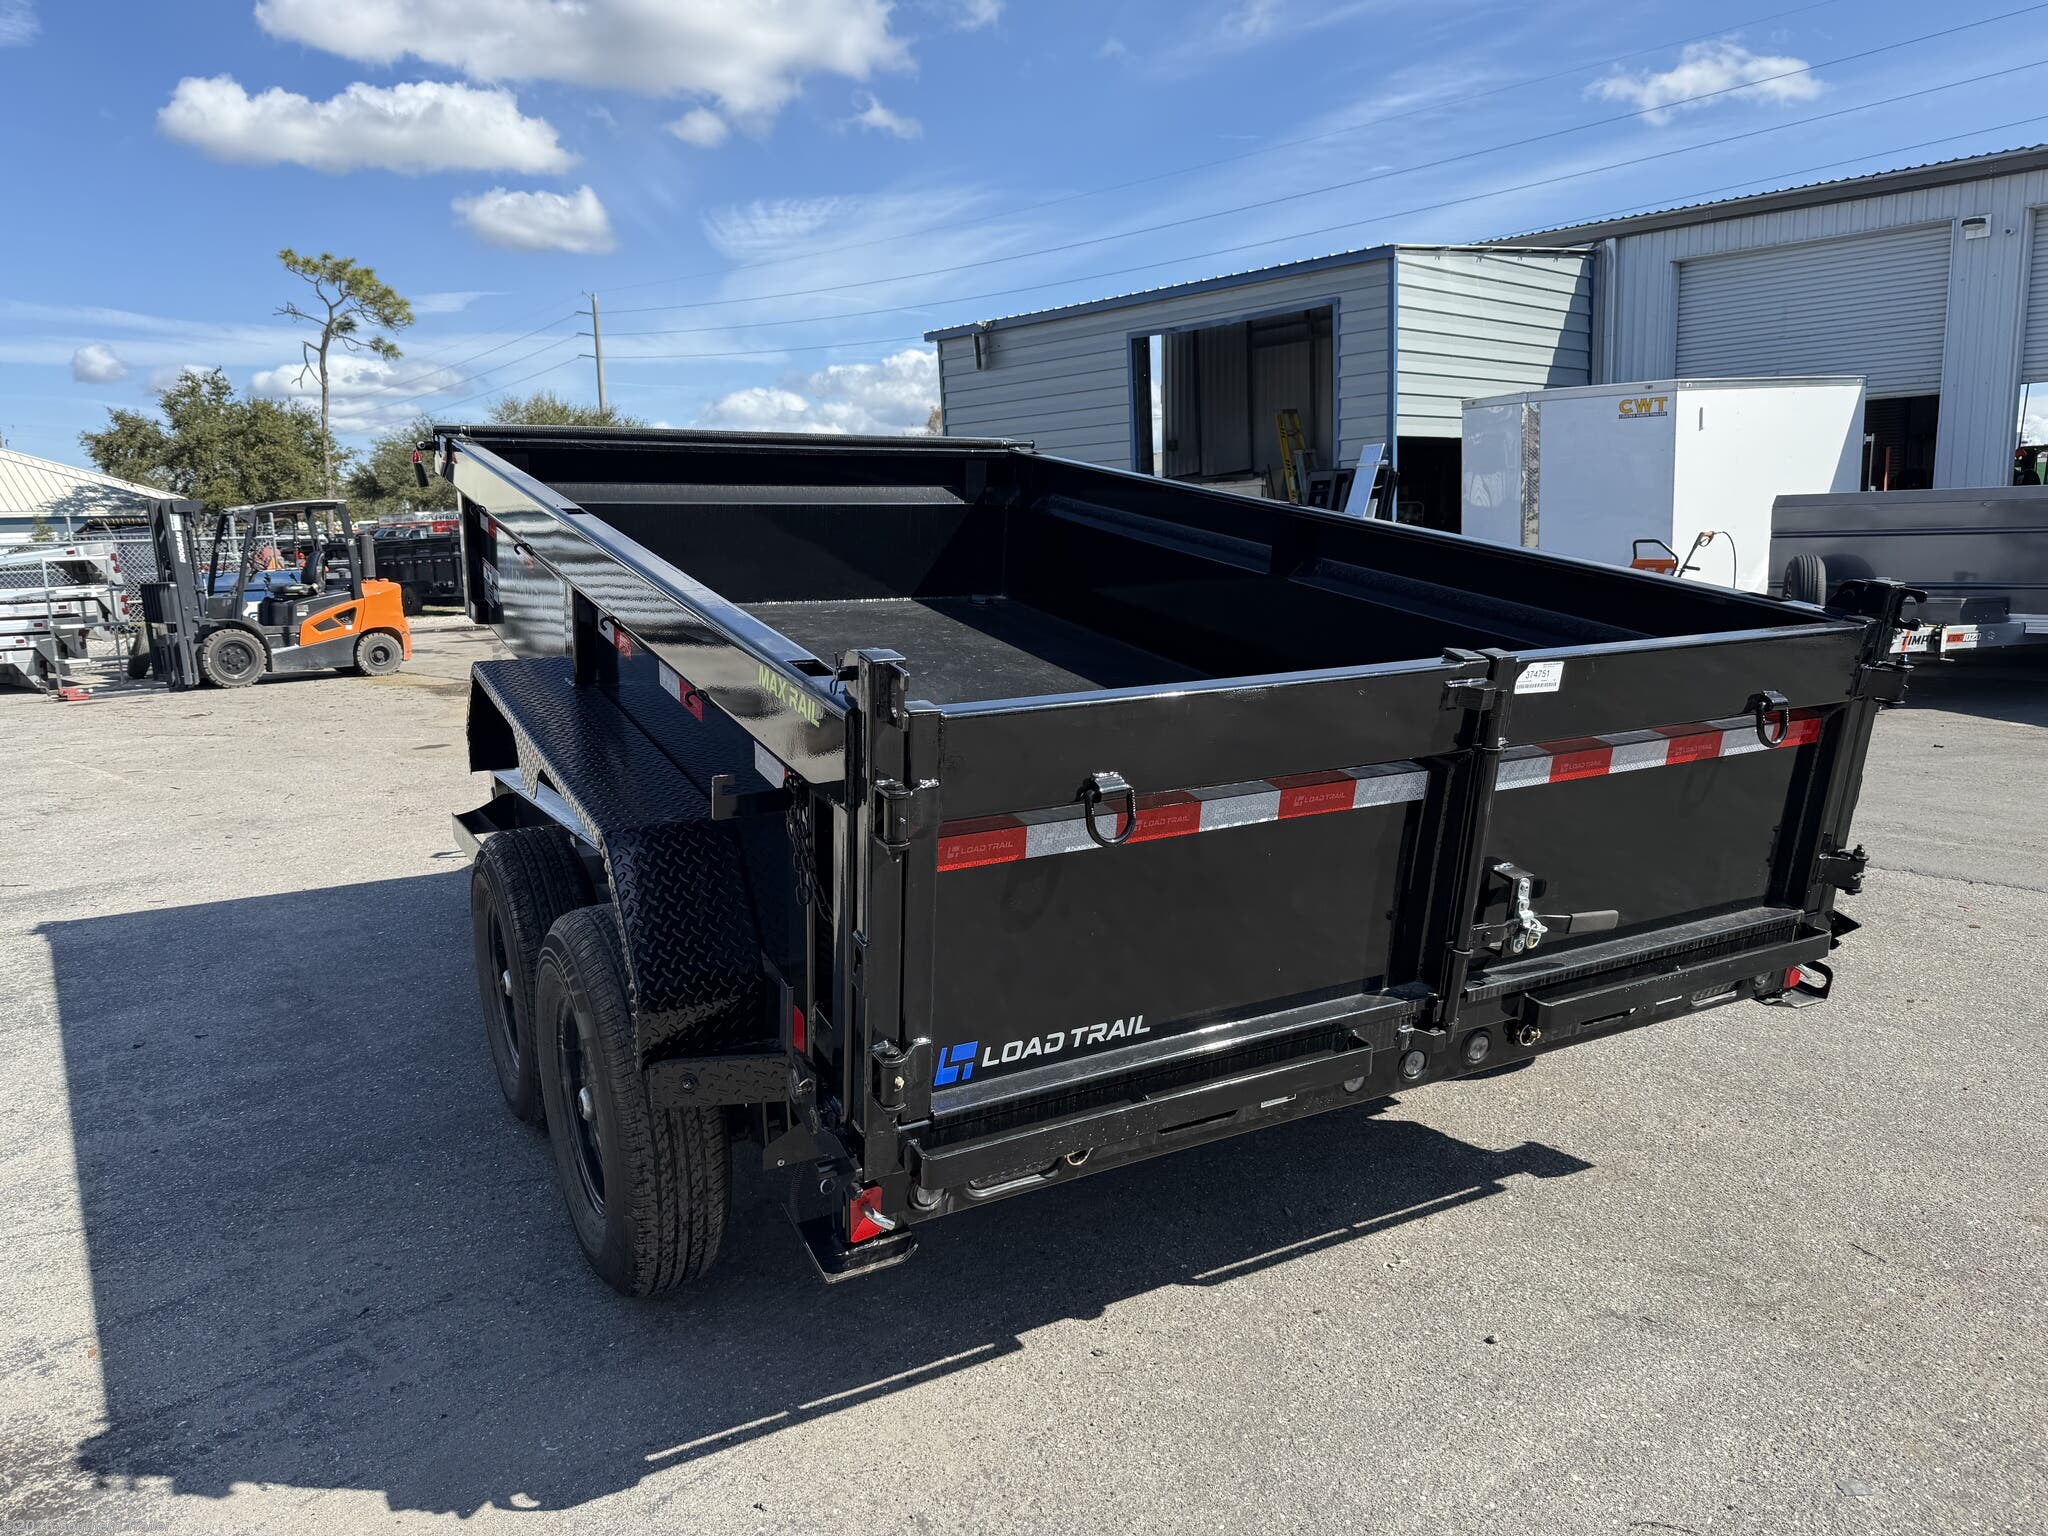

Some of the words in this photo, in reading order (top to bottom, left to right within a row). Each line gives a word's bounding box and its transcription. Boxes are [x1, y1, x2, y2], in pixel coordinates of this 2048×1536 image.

[1618, 396, 1669, 414] CWT
[1525, 669, 1551, 680] 374751
[758, 664, 787, 703] MAX
[789, 686, 820, 728] RAIL
[1304, 795, 1325, 803] LOAD
[1325, 792, 1346, 800] TRAIL
[1143, 818, 1166, 828] LOAD
[1167, 815, 1190, 824] TRAIL
[961, 845, 986, 855] LOAD
[988, 841, 1014, 851] TRAIL
[981, 1032, 1066, 1068] LOAD
[1070, 1015, 1151, 1048] TRAIL
